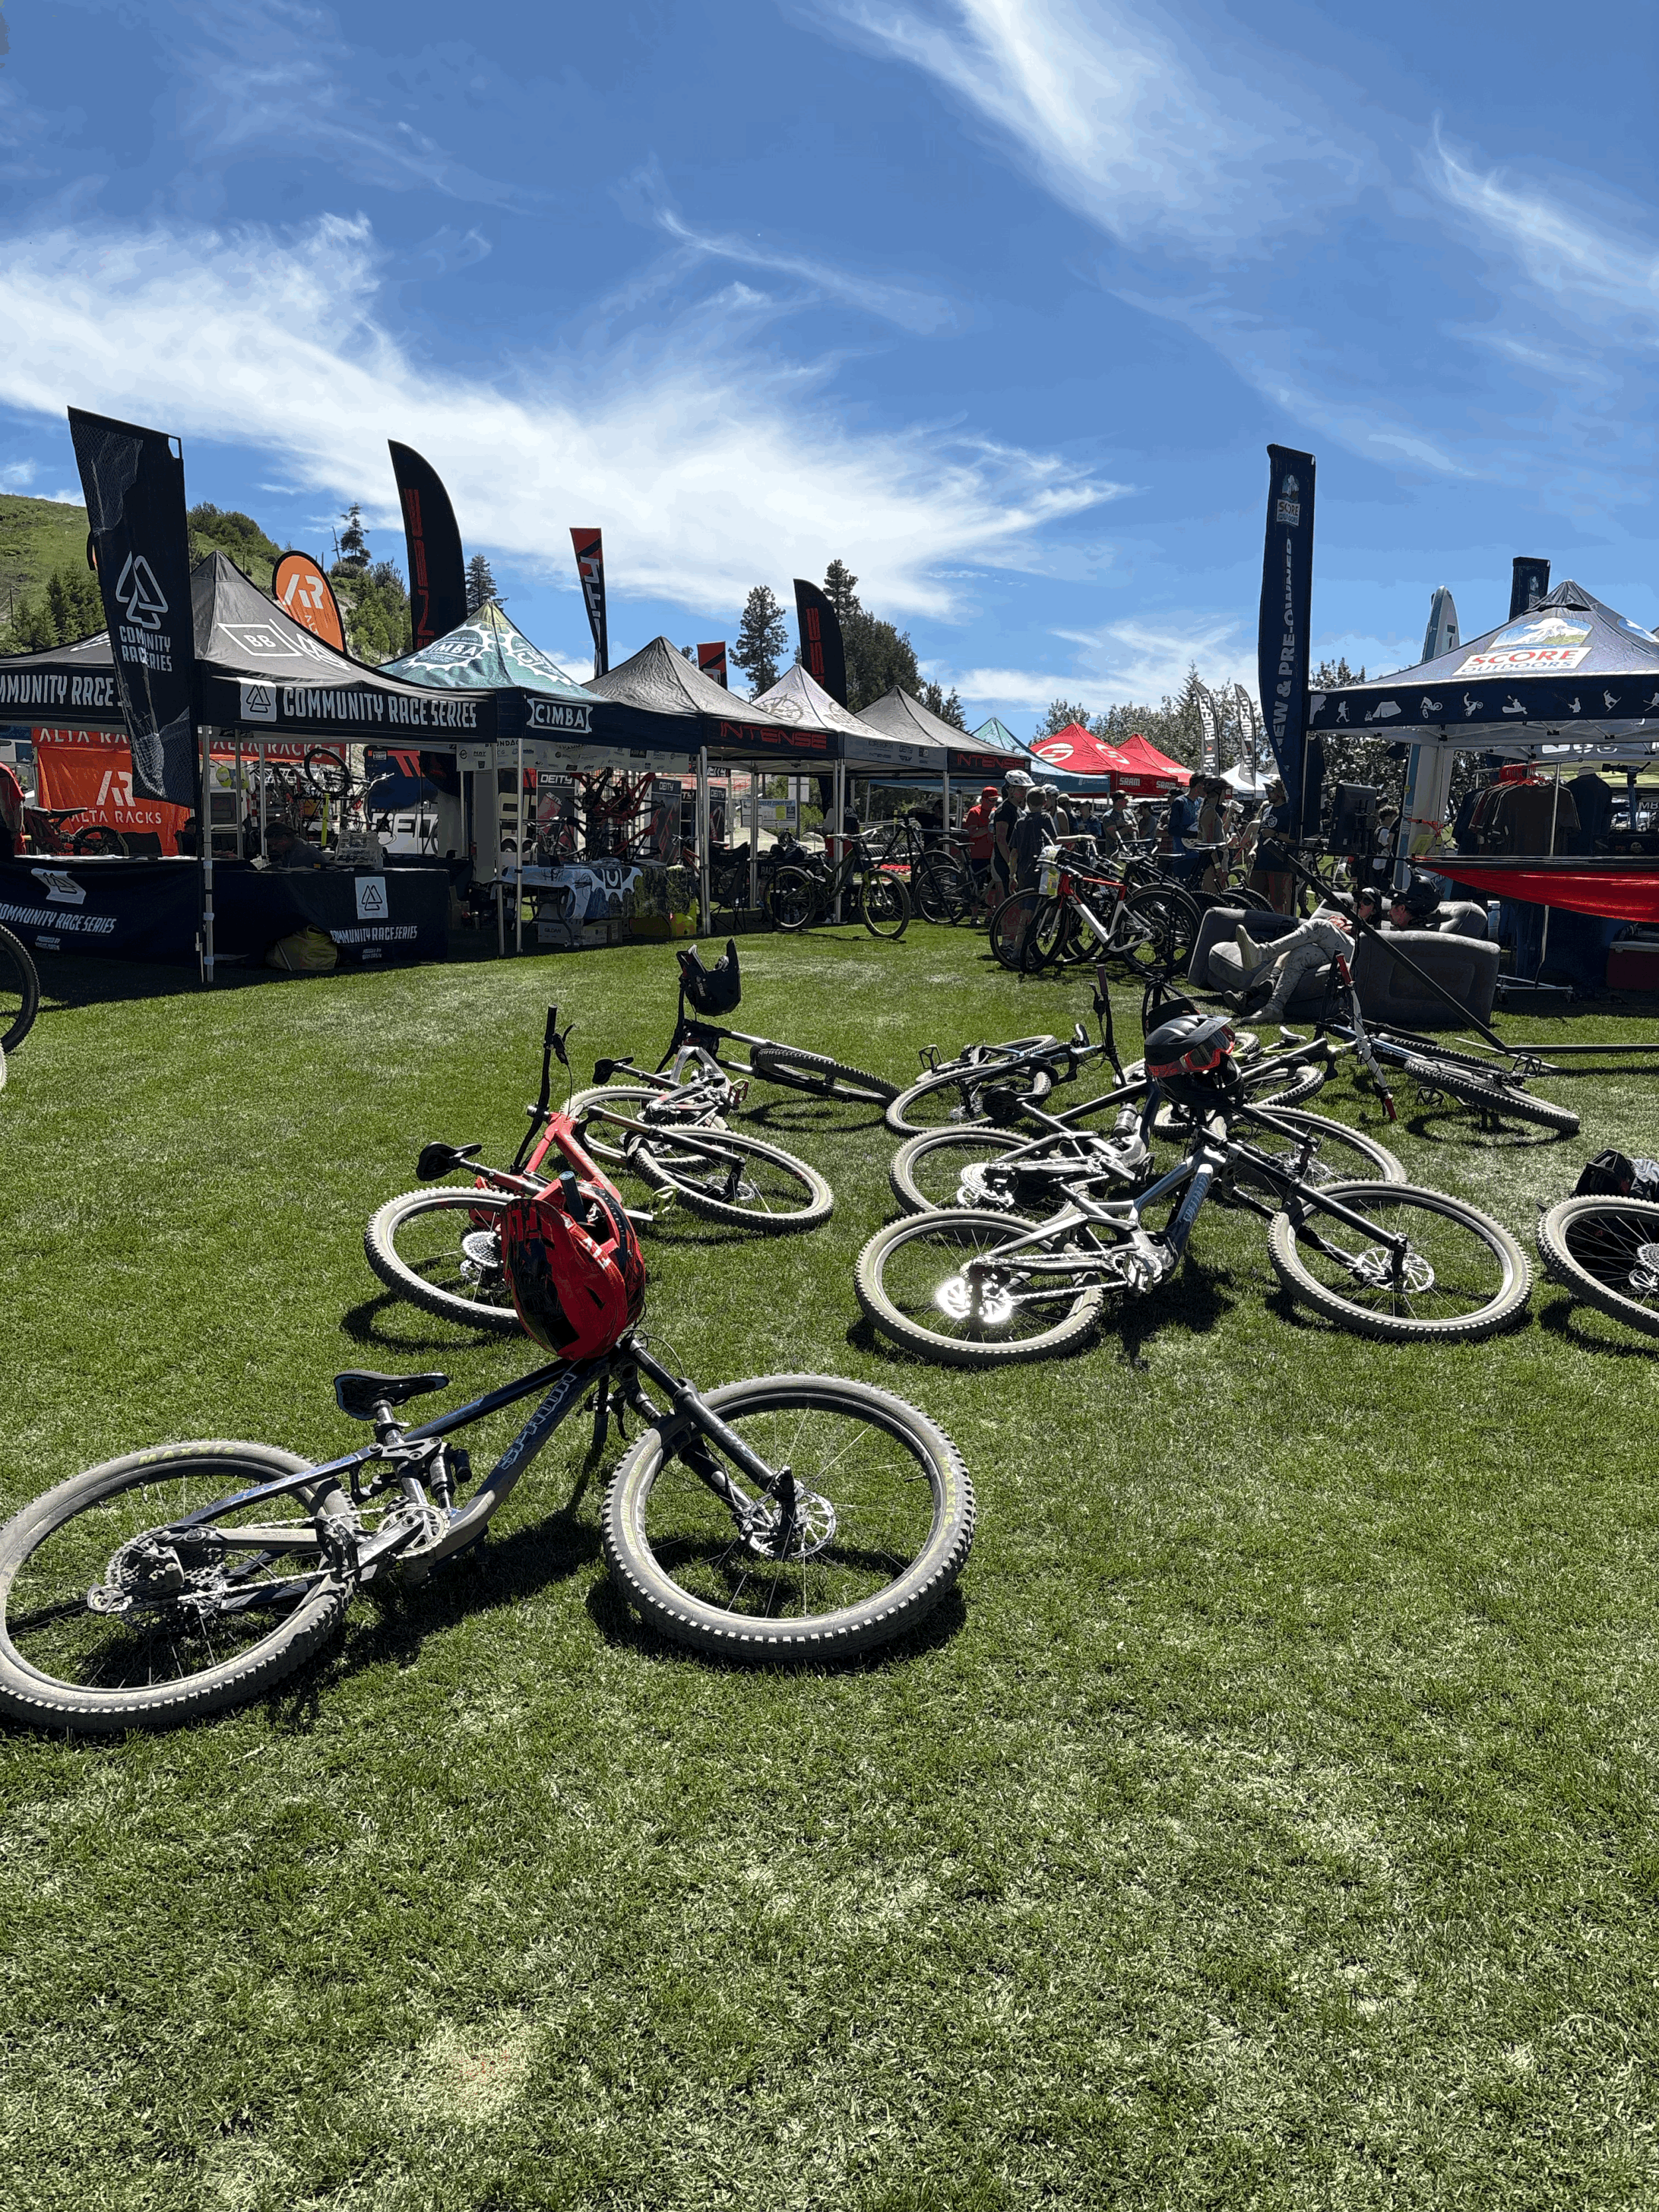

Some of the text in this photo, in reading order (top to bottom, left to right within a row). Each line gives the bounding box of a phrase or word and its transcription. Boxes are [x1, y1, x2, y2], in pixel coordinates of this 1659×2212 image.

[243, 634, 276, 647] BB
[1461, 661, 1573, 673] OUTDOORS
[1469, 650, 1579, 667] SCORE
[0, 674, 114, 706] MMUNITY RACE
[1277, 680, 1292, 698] &
[283, 686, 476, 728] COMMUNITY RACE SERIES
[535, 703, 585, 728] CIMBA
[720, 721, 827, 750] INTENSE
[956, 753, 1025, 770] INTENSE
[540, 774, 573, 784] DEITY
[659, 781, 675, 792] DEITY
[1119, 776, 1141, 786] SRAM
[710, 788, 726, 799] DEITY
[114, 811, 162, 824] RACKS
[55, 913, 85, 930] RACE
[81, 916, 117, 934] SERIES
[372, 926, 395, 941] RACE
[394, 925, 418, 940] SERIES
[138, 1445, 236, 1465] MAXXIS
[939, 1456, 956, 1526] MAXXIS
